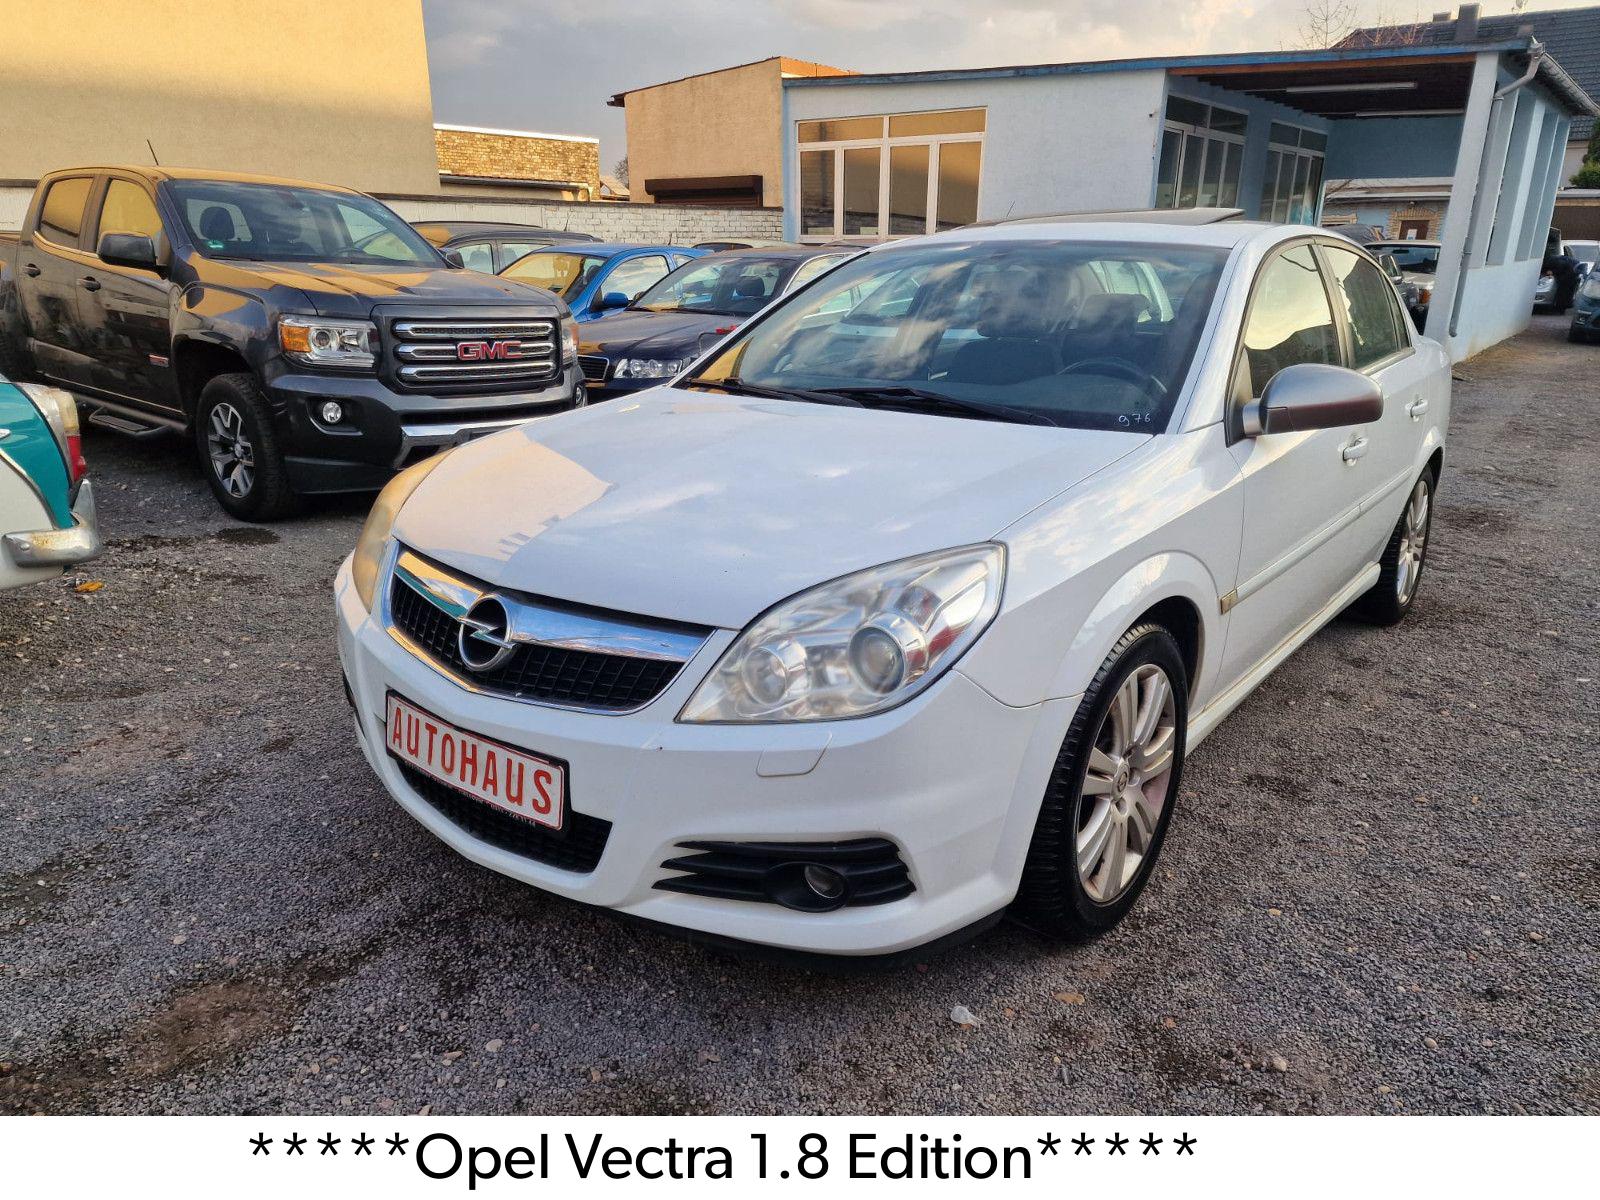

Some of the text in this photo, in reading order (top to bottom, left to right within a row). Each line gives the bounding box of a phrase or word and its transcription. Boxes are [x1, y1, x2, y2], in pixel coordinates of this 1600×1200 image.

[457, 340, 522, 360] GMC
[1118, 413, 1151, 427] 976
[392, 706, 552, 815] AUTOHAUS
